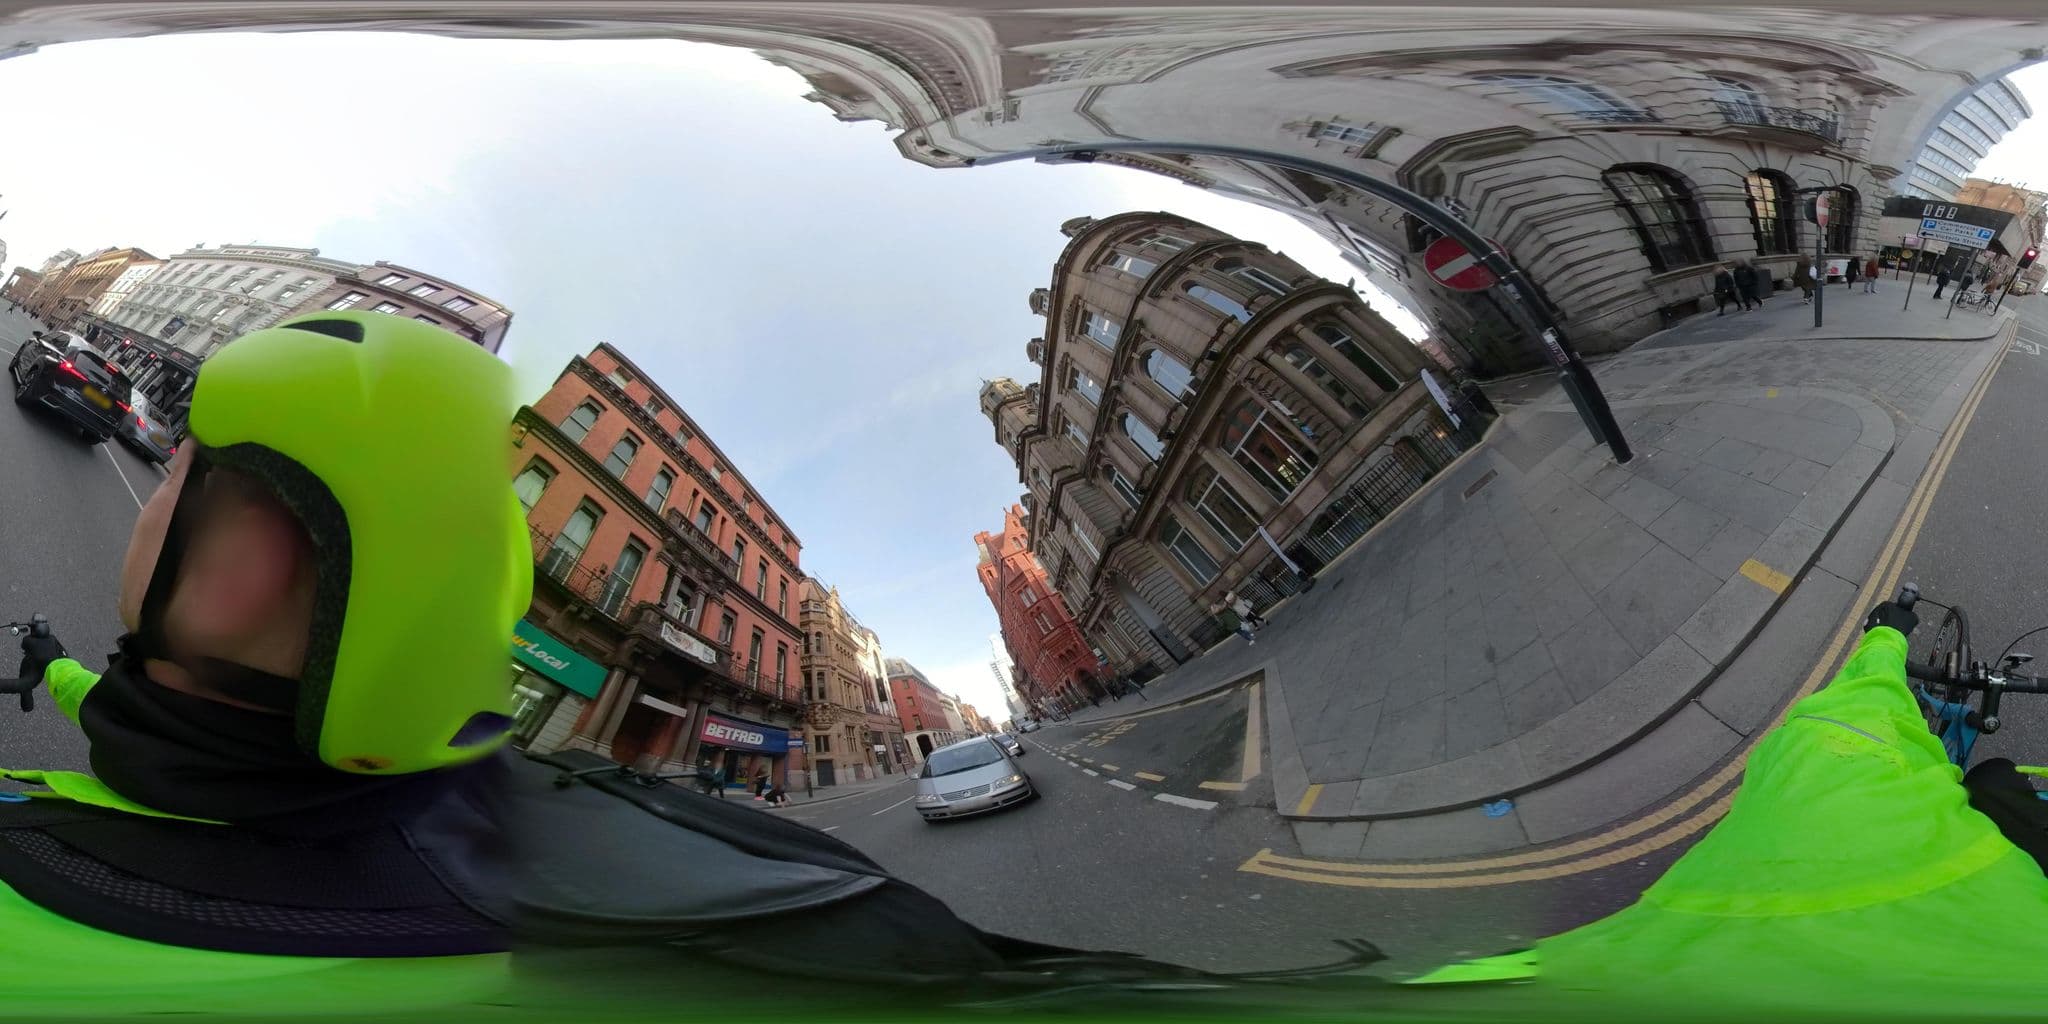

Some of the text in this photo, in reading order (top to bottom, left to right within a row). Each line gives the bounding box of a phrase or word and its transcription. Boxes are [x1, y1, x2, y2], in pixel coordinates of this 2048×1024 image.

[1937, 220, 1979, 232] Commercial
[1935, 233, 1983, 246] Victoria Street
[704, 722, 764, 745] BETFRED
